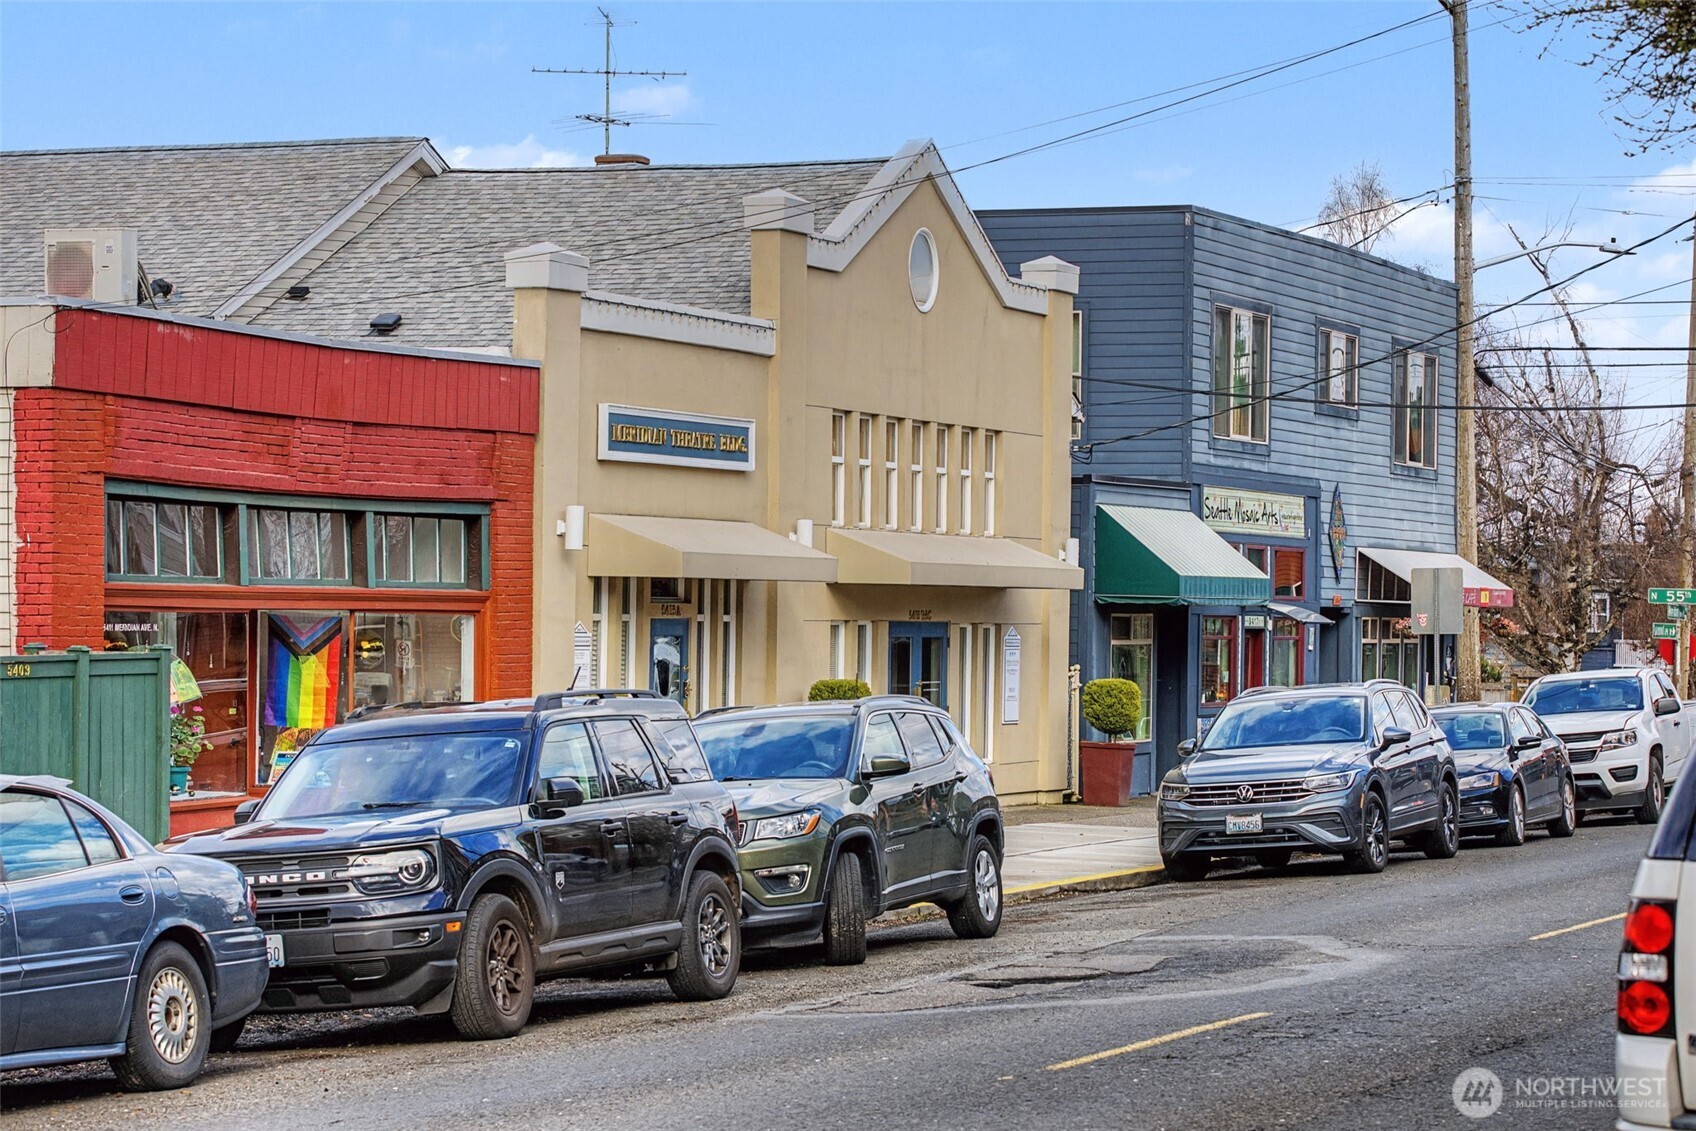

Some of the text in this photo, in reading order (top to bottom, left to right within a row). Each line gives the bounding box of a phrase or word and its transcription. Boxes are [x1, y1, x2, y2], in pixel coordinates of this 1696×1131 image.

[611, 423, 667, 446] MERIDIAN
[671, 428, 716, 450] THEATRE
[1204, 497, 1233, 520] Seattle
[1235, 498, 1260, 524] Mosaic
[1261, 502, 1279, 526] Arts
[1651, 590, 1692, 602] N 55th
[7, 664, 31, 677] 5409
